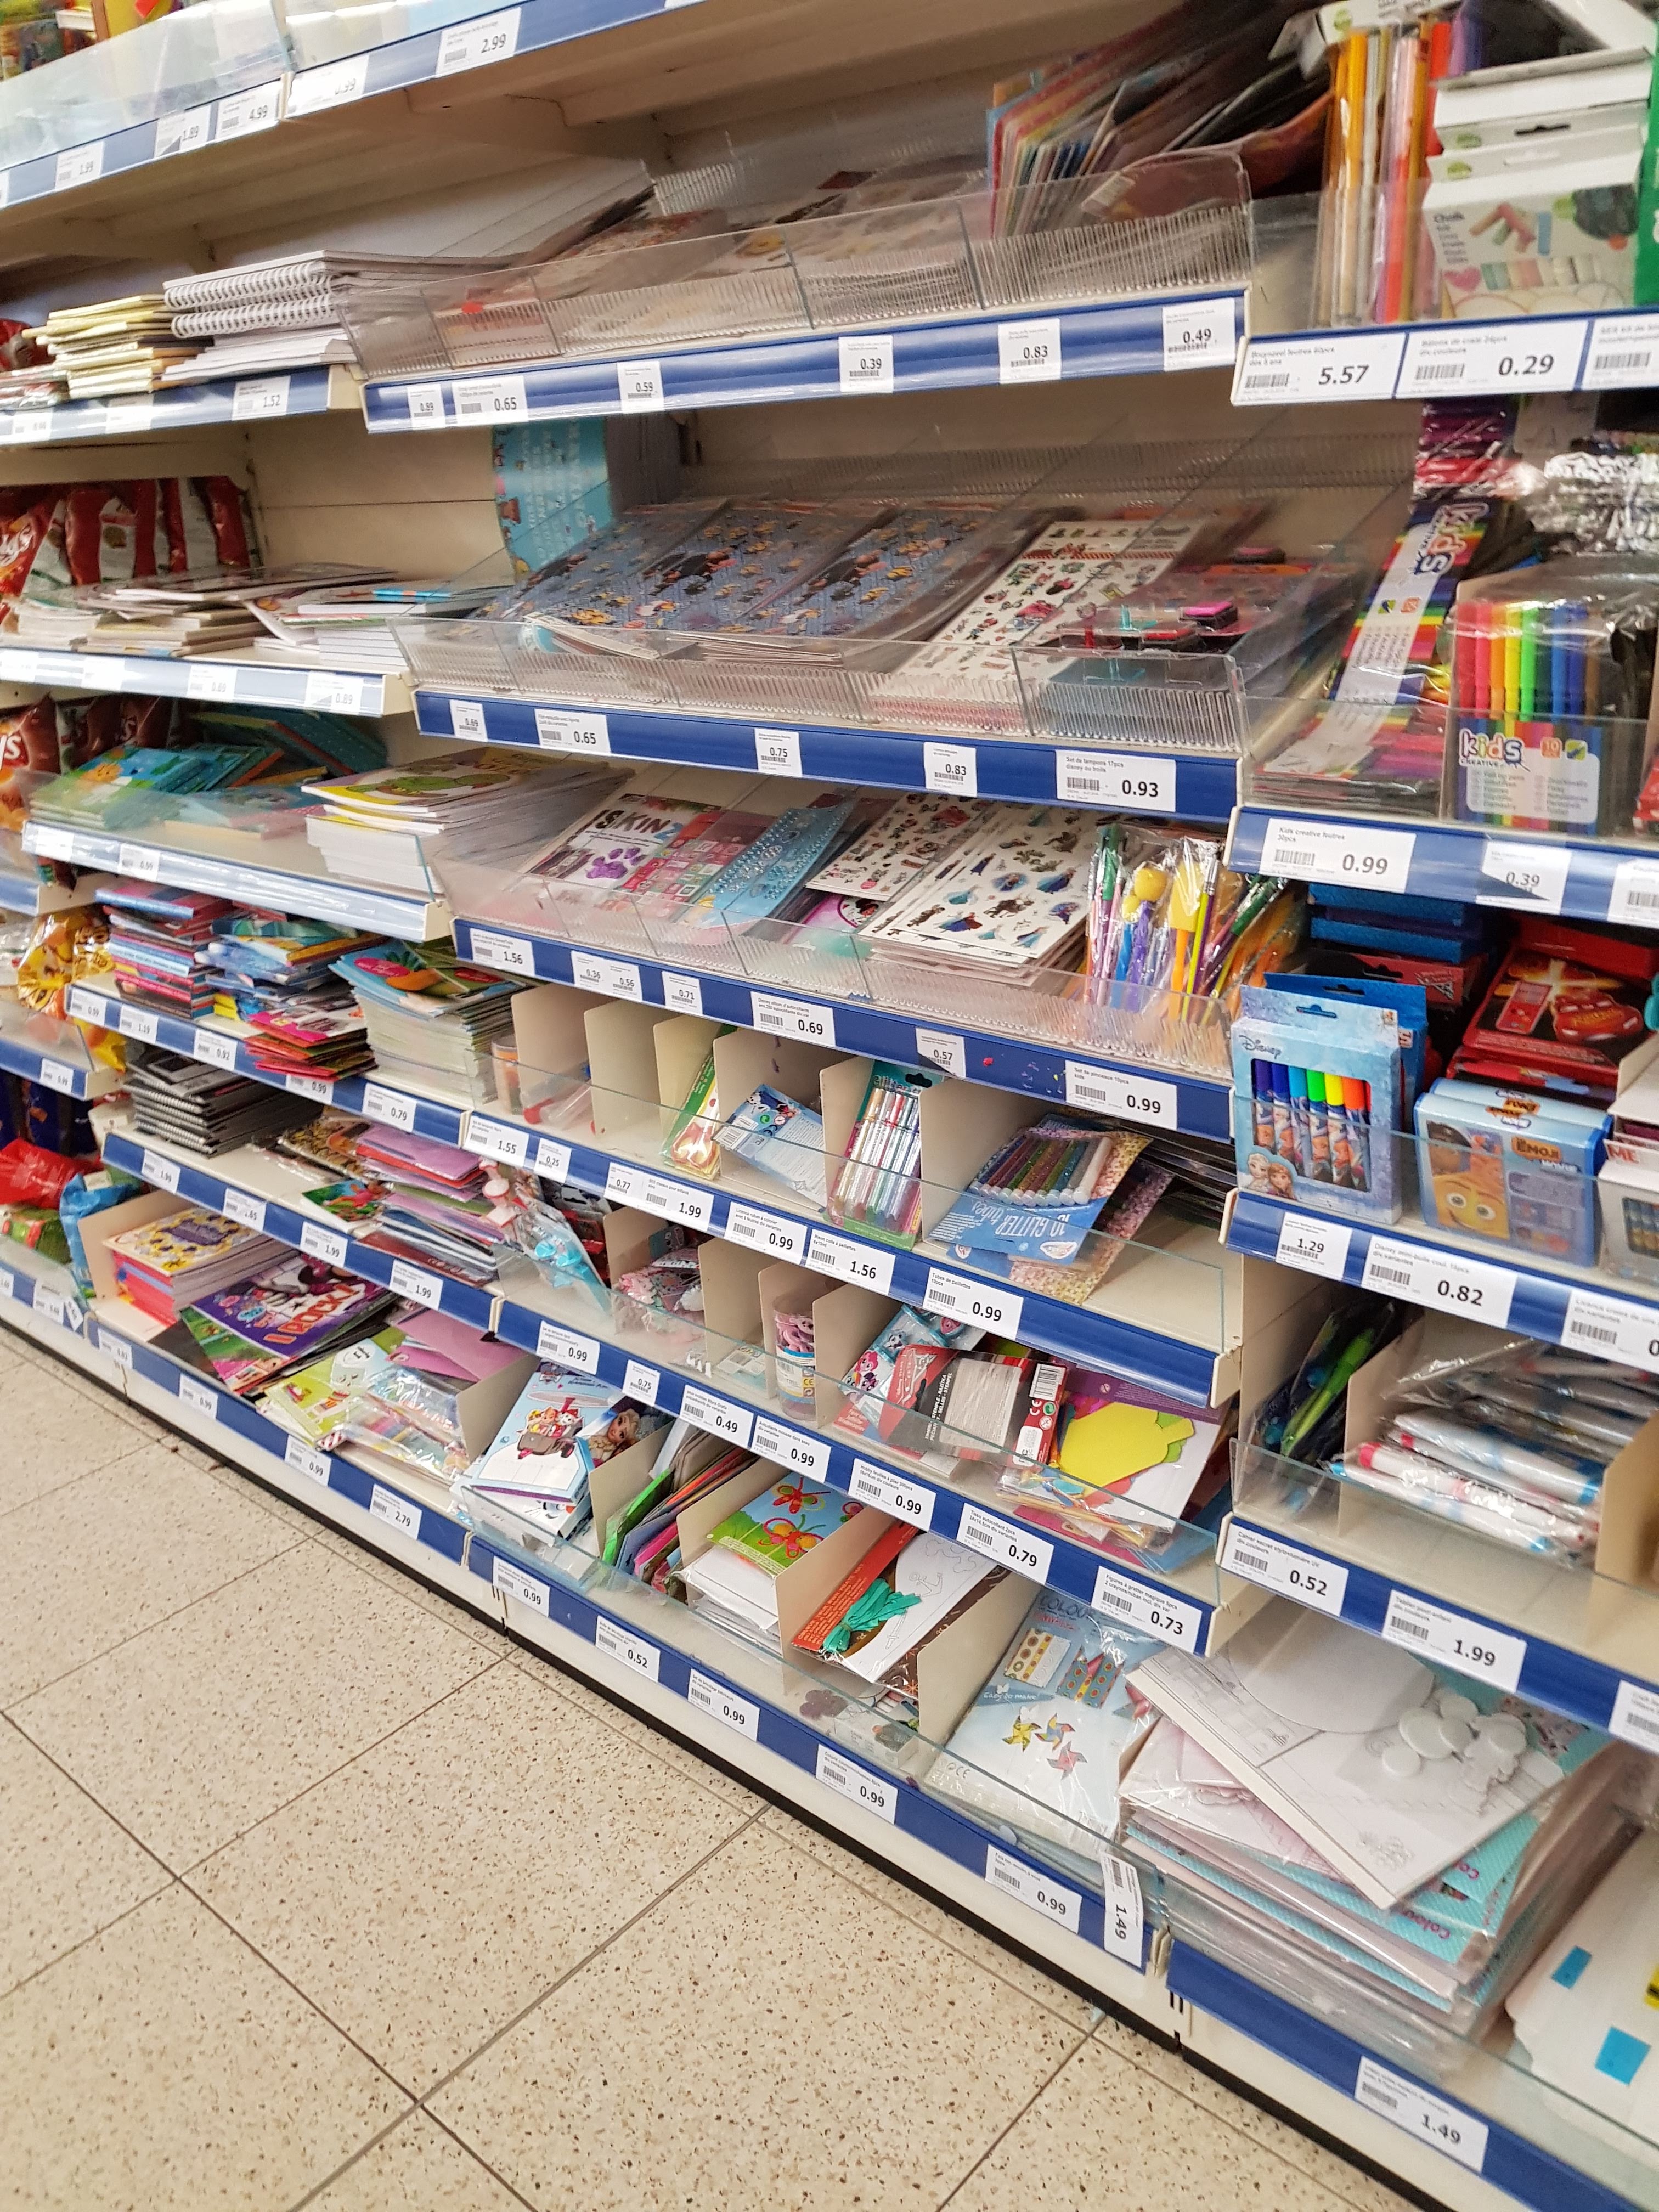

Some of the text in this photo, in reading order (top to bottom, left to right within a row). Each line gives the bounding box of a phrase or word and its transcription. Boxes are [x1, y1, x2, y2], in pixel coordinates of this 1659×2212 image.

[481, 33, 506, 54] 2.99
[1183, 328, 1212, 344] 0.49
[1023, 345, 1048, 359] 0.83
[860, 358, 882, 370] 0.39
[1498, 354, 1555, 377] 0.29
[1318, 364, 1370, 385] 5.57
[263, 394, 281, 409] 1.52
[494, 396, 517, 412] 0.65
[573, 731, 596, 744] 0.65
[769, 747, 788, 757] 0.75
[1460, 729, 1524, 765] kids
[945, 764, 967, 775] 0.83
[1121, 779, 1159, 798] 0.93
[1342, 853, 1388, 874] 0.99
[1506, 871, 1541, 888] 0.39
[503, 951, 524, 965] 1.56
[619, 977, 635, 988] 0.56
[679, 989, 695, 1000] 0.71
[798, 1019, 823, 1035] 0.69
[933, 1049, 953, 1060] 0.57
[1239, 1035, 1282, 1059] Disney
[1126, 1094, 1161, 1114] 0.99
[391, 1107, 407, 1121] 0.79
[497, 1140, 517, 1154] 1.55
[1516, 1138, 1561, 1161] EMOJI
[546, 1156, 560, 1167] 0.25
[616, 1178, 631, 1190] 0.77
[679, 1201, 702, 1218] 1.99
[995, 1214, 1047, 1238] GLITTER
[769, 1232, 793, 1250] 0.99
[1296, 1238, 1325, 1253] 1.29
[325, 1244, 340, 1257] 1.99
[850, 1260, 877, 1279] 1.56
[932, 1272, 945, 1282] Tubes
[951, 1279, 971, 1290] paillettes
[416, 1285, 432, 1299] 1.99
[1437, 1279, 1483, 1306] 0.82
[972, 1301, 1002, 1322] 0.99
[568, 1347, 588, 1362] 0.99
[637, 1378, 652, 1390] 0.75
[944, 1372, 953, 1393] STEMPEL
[199, 1397, 212, 1411] 0.99
[716, 1415, 738, 1433] 0.49
[791, 1448, 815, 1466] 0.99
[309, 1461, 324, 1476] 0.99
[860, 1465, 872, 1474] Hobby
[895, 1494, 922, 1515] 0.99
[394, 1510, 411, 1527] 2.79
[970, 1510, 982, 1519] Tissu
[982, 1516, 1005, 1531] autocollant
[1008, 1544, 1037, 1567] 0.79
[1106, 1573, 1124, 1587] Figures
[1289, 1569, 1328, 1597] 0.52
[523, 1588, 542, 1605] 0.99
[1150, 1610, 1184, 1635] 0.73
[628, 1649, 648, 1668] 0.52
[1453, 1639, 1496, 1667] 1.99
[723, 1705, 746, 1725] 0.99
[859, 1785, 886, 1808] 0.99
[1036, 1890, 1067, 1916] 0.99
[1114, 1903, 1128, 1941] 1.49
[1420, 2113, 1462, 2145] 1.49
